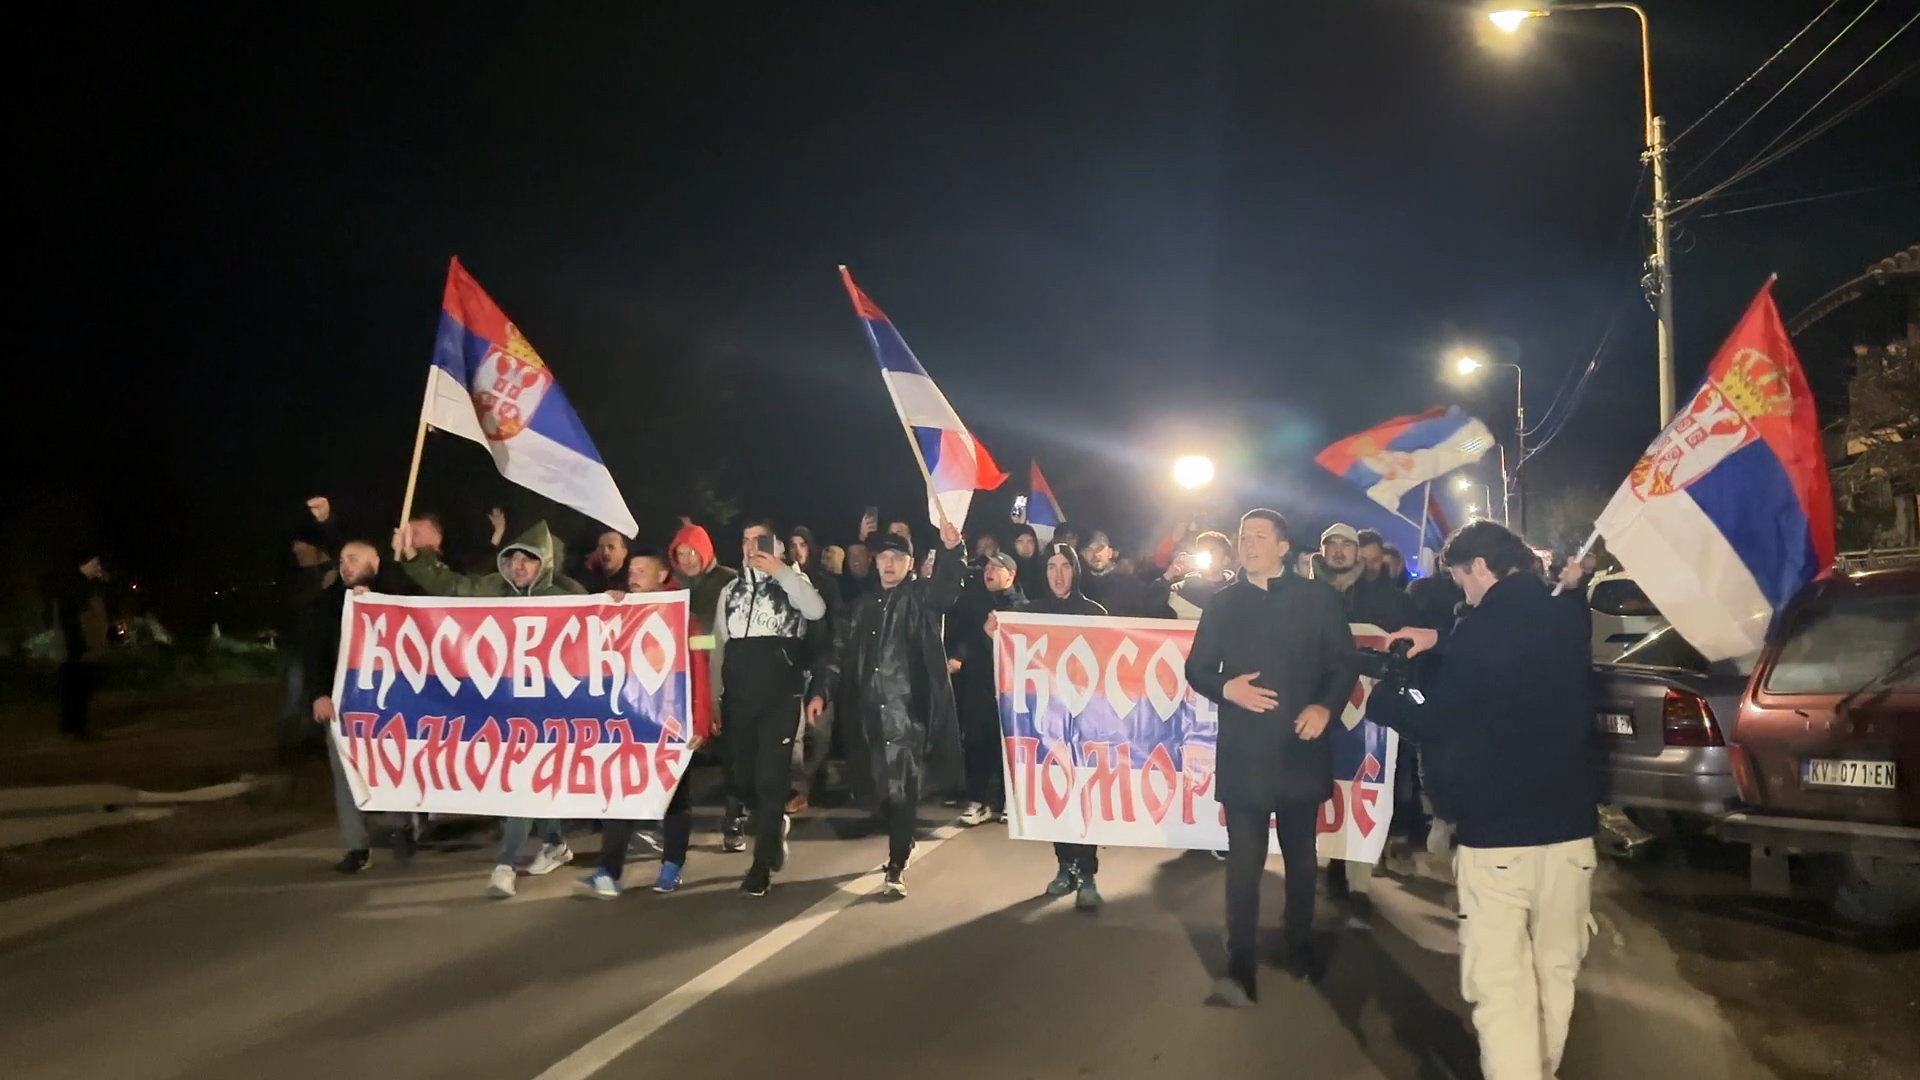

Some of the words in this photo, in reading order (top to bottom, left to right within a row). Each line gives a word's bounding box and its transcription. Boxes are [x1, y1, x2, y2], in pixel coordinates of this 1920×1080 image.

[358, 611, 676, 715] КОСОВСКО
[342, 712, 683, 812] ПОМОРАВЉЕ
[1005, 735, 1381, 839] ПОМОРЕ
